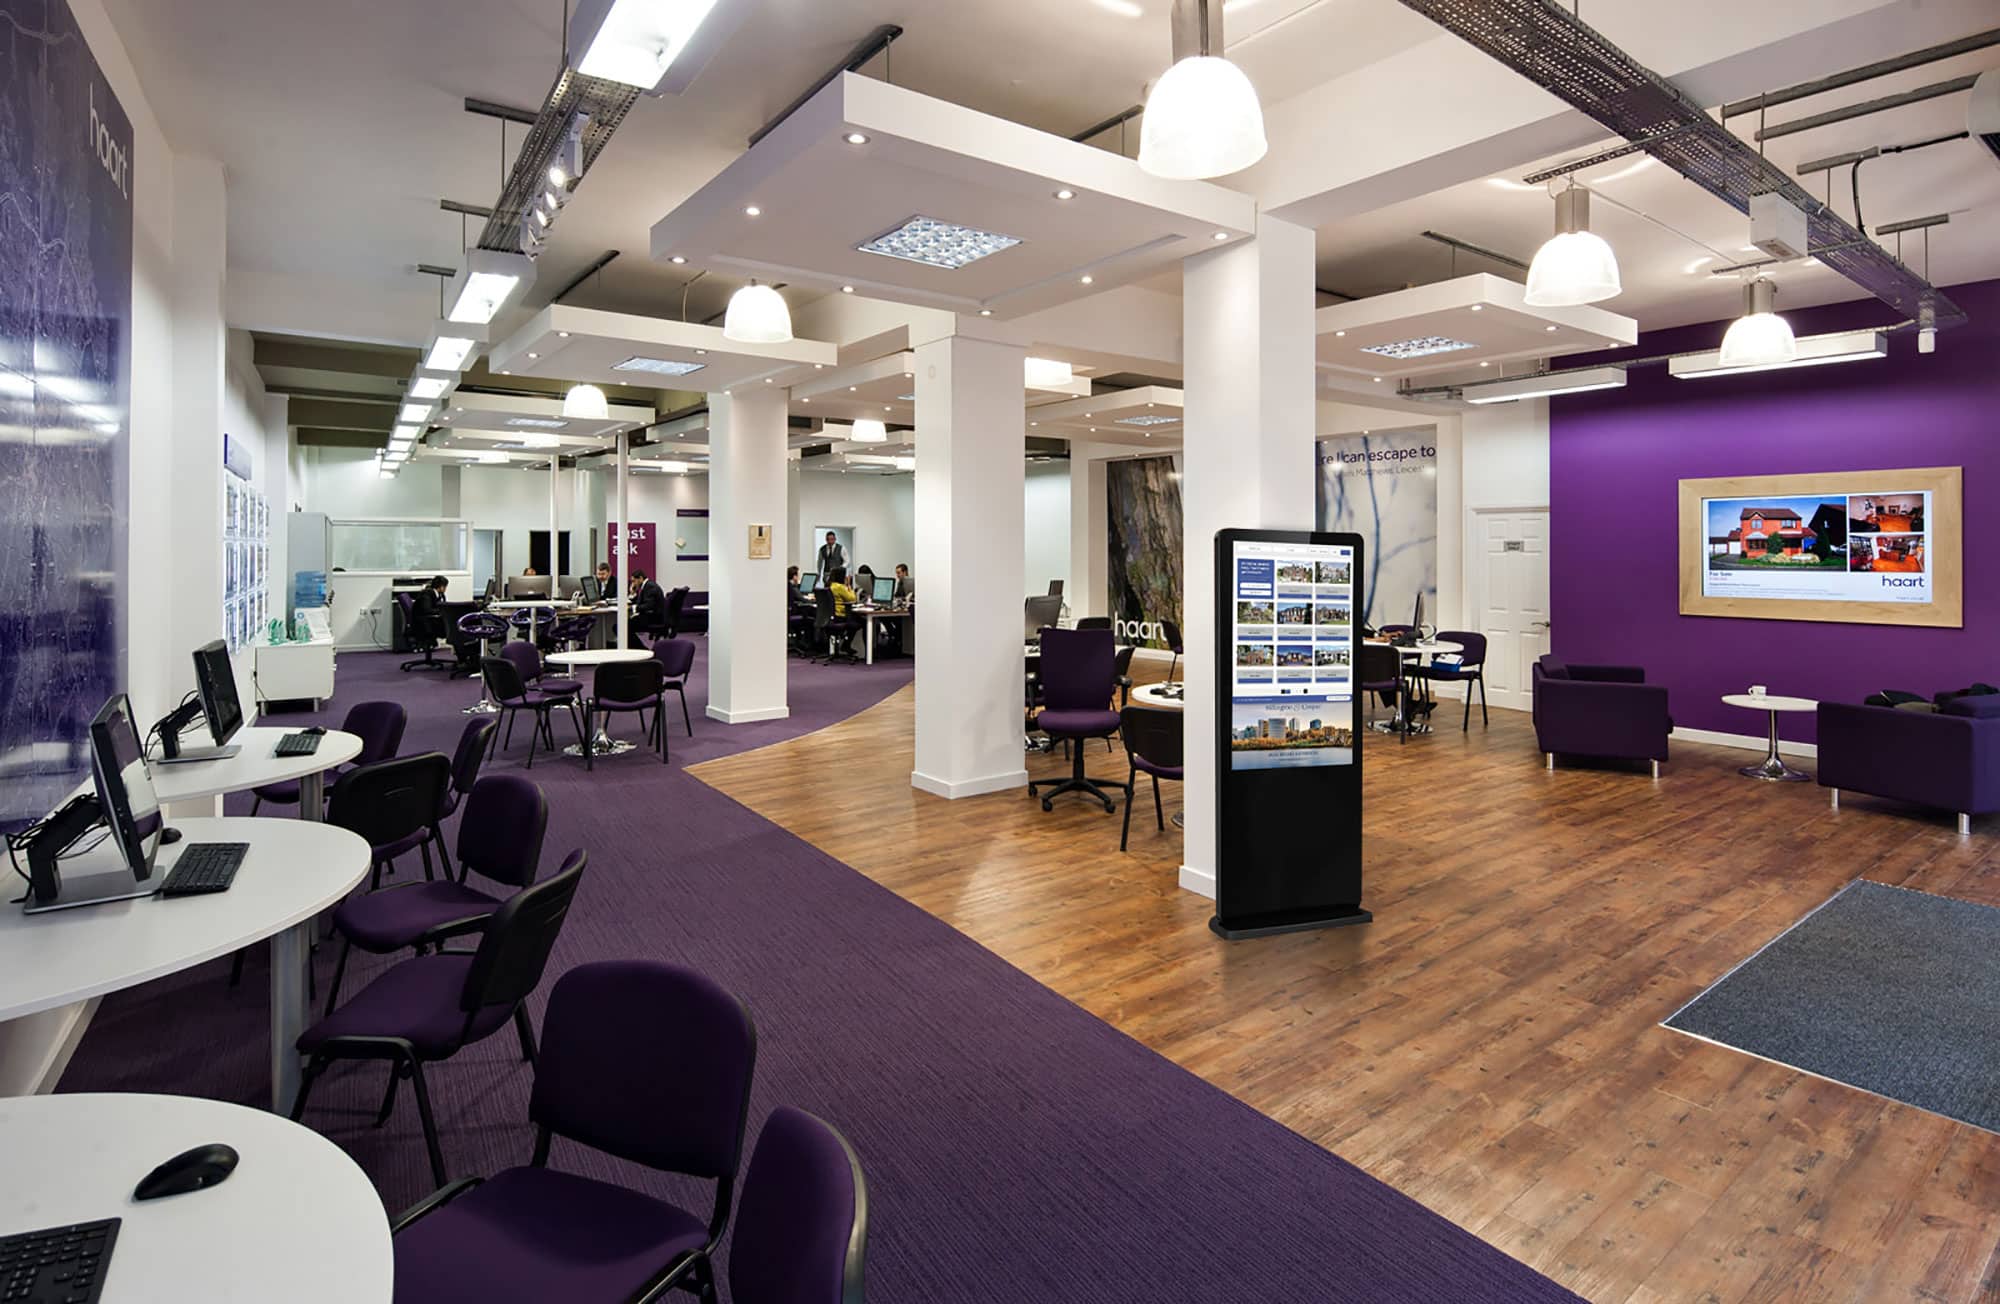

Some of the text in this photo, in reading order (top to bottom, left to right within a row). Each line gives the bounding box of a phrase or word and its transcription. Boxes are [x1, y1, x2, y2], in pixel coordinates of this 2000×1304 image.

[89, 82, 128, 201] haart
[1343, 452, 1366, 464] can
[1367, 447, 1418, 462] escape
[1420, 445, 1436, 458] to
[1881, 575, 1925, 588] haart
